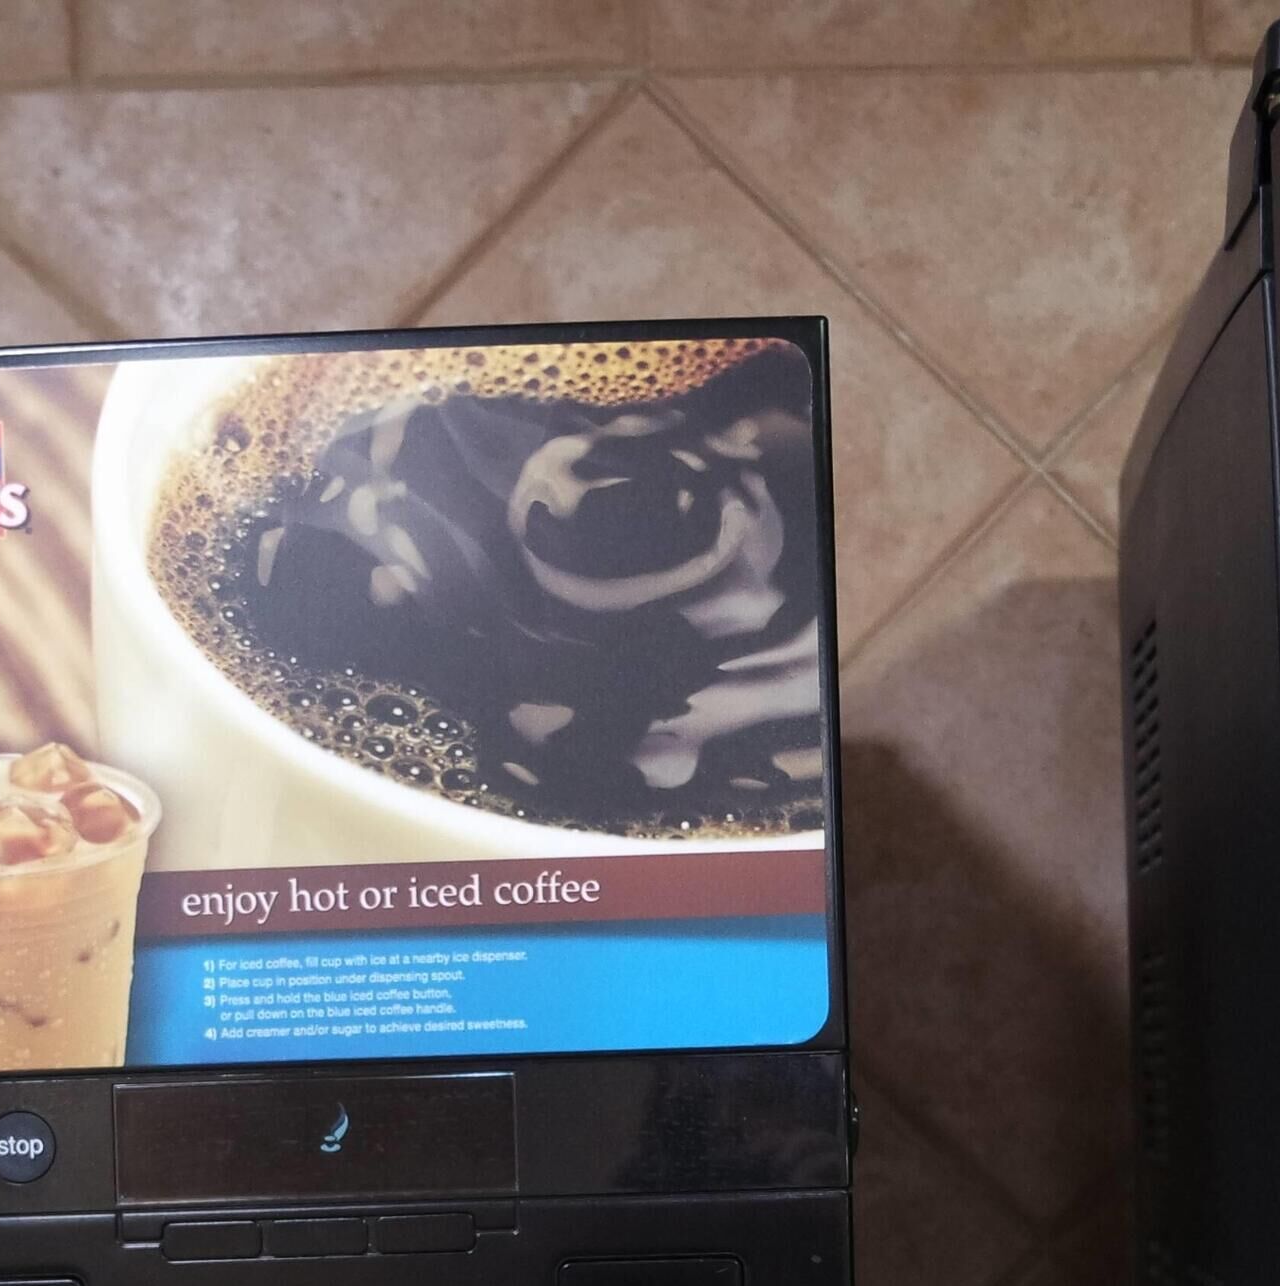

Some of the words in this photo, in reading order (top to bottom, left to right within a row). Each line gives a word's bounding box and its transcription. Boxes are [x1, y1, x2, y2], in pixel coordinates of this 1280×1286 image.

[182, 884, 279, 925] enjoy
[288, 878, 349, 913] hot
[359, 884, 397, 911] or
[408, 874, 481, 909] iced
[494, 871, 600, 906] coffee
[204, 959, 215, 973] 1)
[219, 959, 237, 970] For
[240, 958, 263, 969] iced
[321, 957, 342, 969] cup
[344, 955, 368, 966] with
[370, 955, 387, 965] ice
[389, 954, 400, 965] at
[402, 955, 410, 965] a
[412, 953, 450, 966] nearby
[452, 951, 469, 963] ice
[203, 977, 216, 990] 2)
[219, 976, 250, 988] Place
[252, 977, 273, 989] cup
[276, 975, 286, 986] in
[288, 974, 332, 987] position
[335, 973, 366, 984] under
[369, 971, 429, 985] dispensing
[203, 995, 216, 1009] 3)
[220, 994, 250, 1006] Press
[253, 993, 274, 1005] and
[276, 992, 301, 1004] hold
[303, 991, 320, 1003] the
[323, 990, 348, 1002] blue
[350, 990, 374, 1001] iced
[376, 988, 410, 1000] coffee
[220, 1011, 232, 1021] or
[234, 1009, 255, 1022] pull
[257, 1009, 288, 1020] down
[290, 1009, 305, 1019] on
[307, 1007, 324, 1018] the
[327, 1006, 351, 1017] blue
[353, 1006, 376, 1016] iced
[379, 1004, 414, 1015] coffee
[205, 1027, 217, 1040] 4)
[221, 1027, 244, 1038] Add
[246, 1027, 291, 1038] creamer
[293, 1024, 329, 1036] and/or
[331, 1024, 363, 1037] sugar
[365, 1022, 376, 1033] to
[379, 1021, 422, 1033] achieve
[424, 1020, 465, 1031] desired
